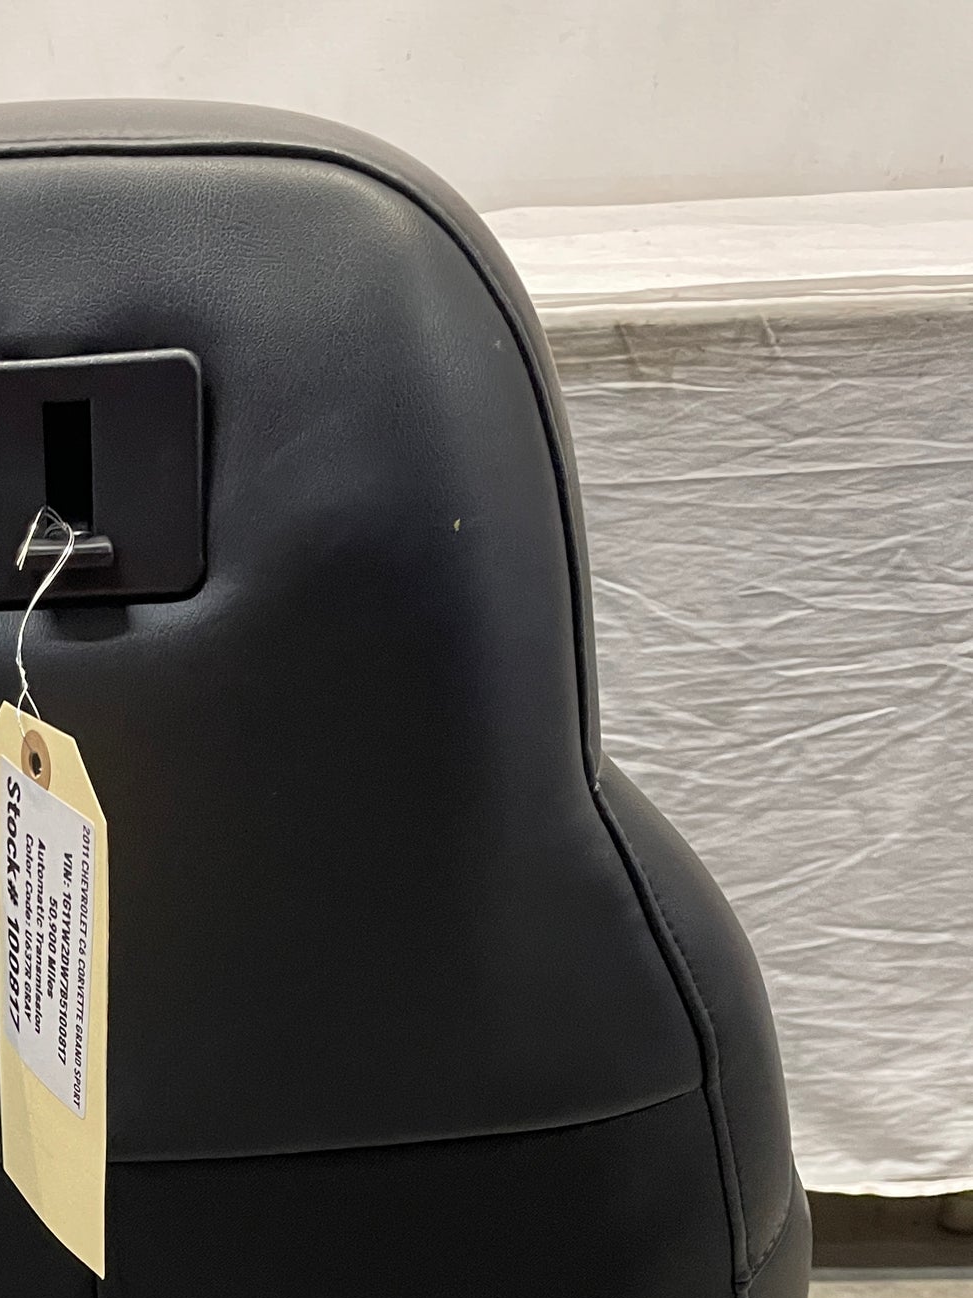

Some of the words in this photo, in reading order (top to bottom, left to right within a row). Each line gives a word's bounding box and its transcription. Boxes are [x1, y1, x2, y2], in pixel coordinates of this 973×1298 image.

[7, 776, 21, 907] Stock#
[25, 833, 34, 878] Color
[81, 824, 91, 859] 2011
[36, 838, 46, 928] Automatic
[63, 852, 73, 888] VIN:
[25, 880, 33, 927] Code:
[80, 860, 90, 937] CHEVROLET
[48, 896, 58, 954] 50,900
[78, 938, 87, 955] C6
[7, 916, 20, 1033] 100817
[34, 931, 44, 1034] Transmission
[46, 955, 57, 999] Miles
[75, 958, 86, 1025] CORVETTE
[24, 981, 32, 1023] GRAY
[74, 1025, 84, 1067] GRAND
[73, 1068, 82, 1109] SPORT
